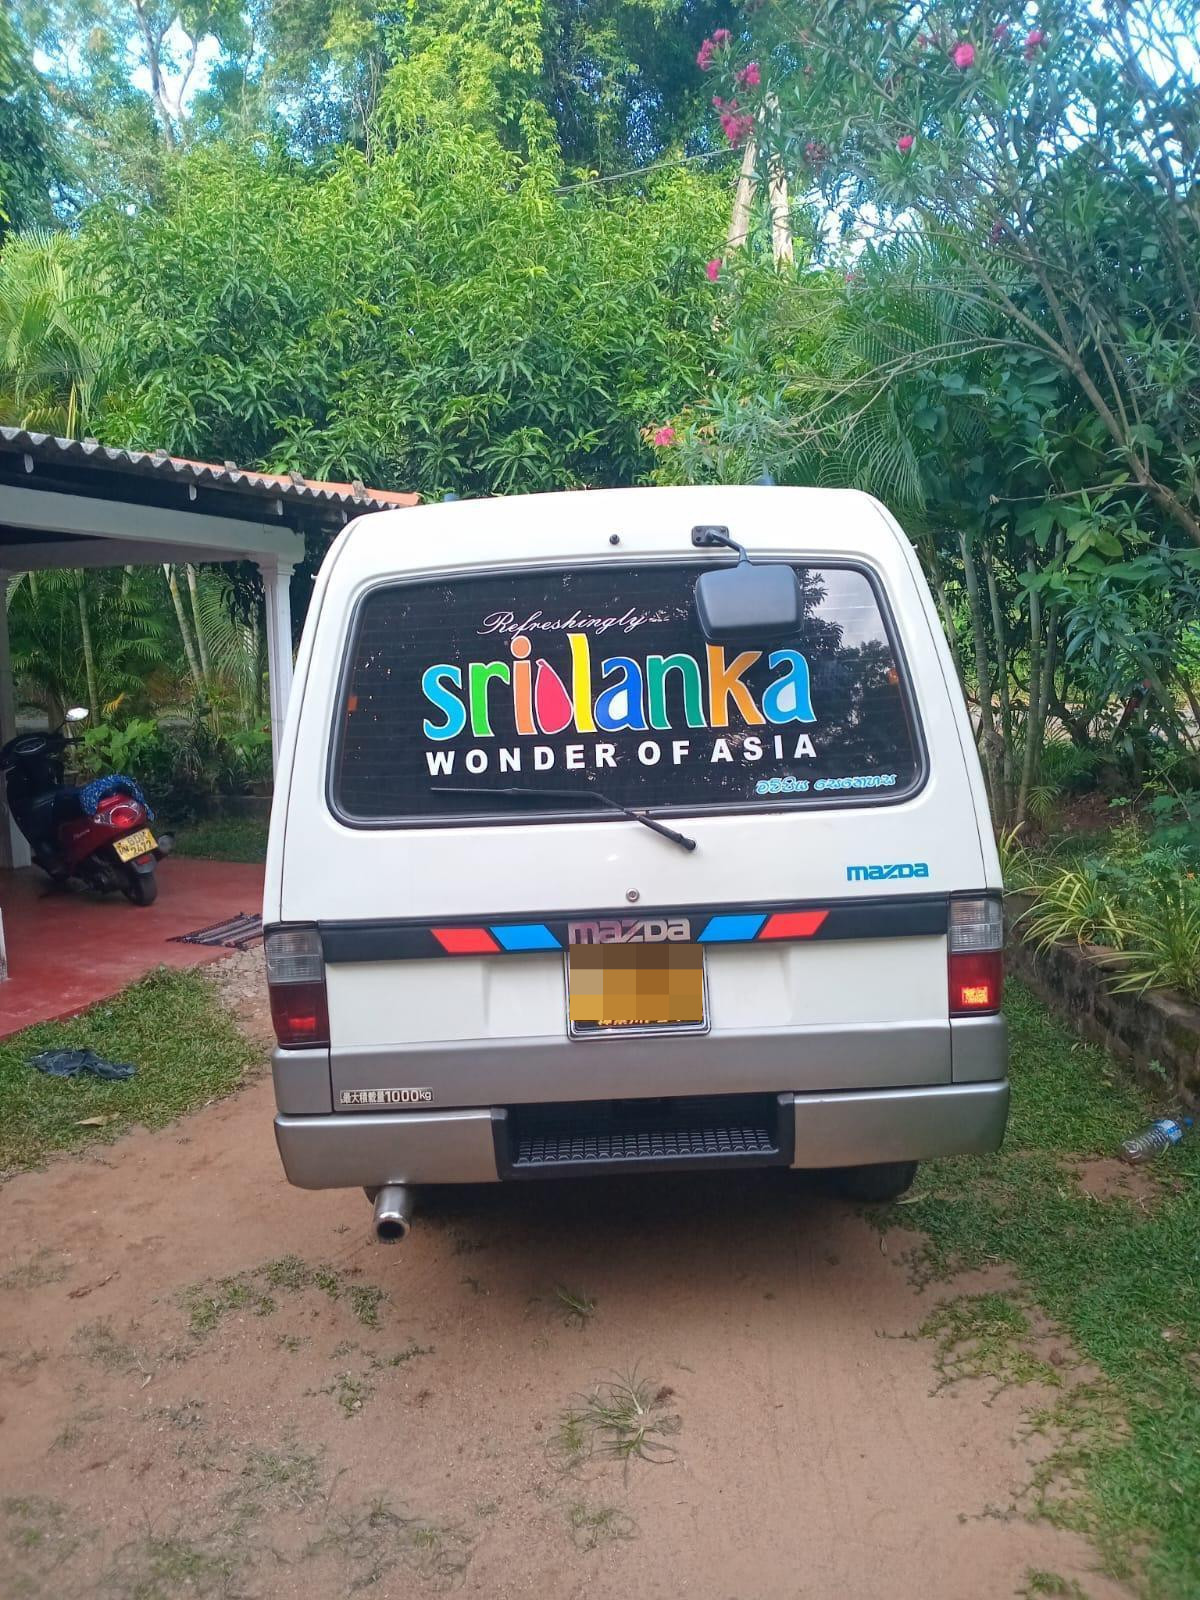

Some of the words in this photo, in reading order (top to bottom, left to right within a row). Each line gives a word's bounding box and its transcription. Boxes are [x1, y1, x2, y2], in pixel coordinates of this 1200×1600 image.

[477, 608, 648, 639] Refreshingly
[425, 743, 617, 776] WONDER
[637, 739, 691, 765] OF
[710, 734, 817, 762] ASIA
